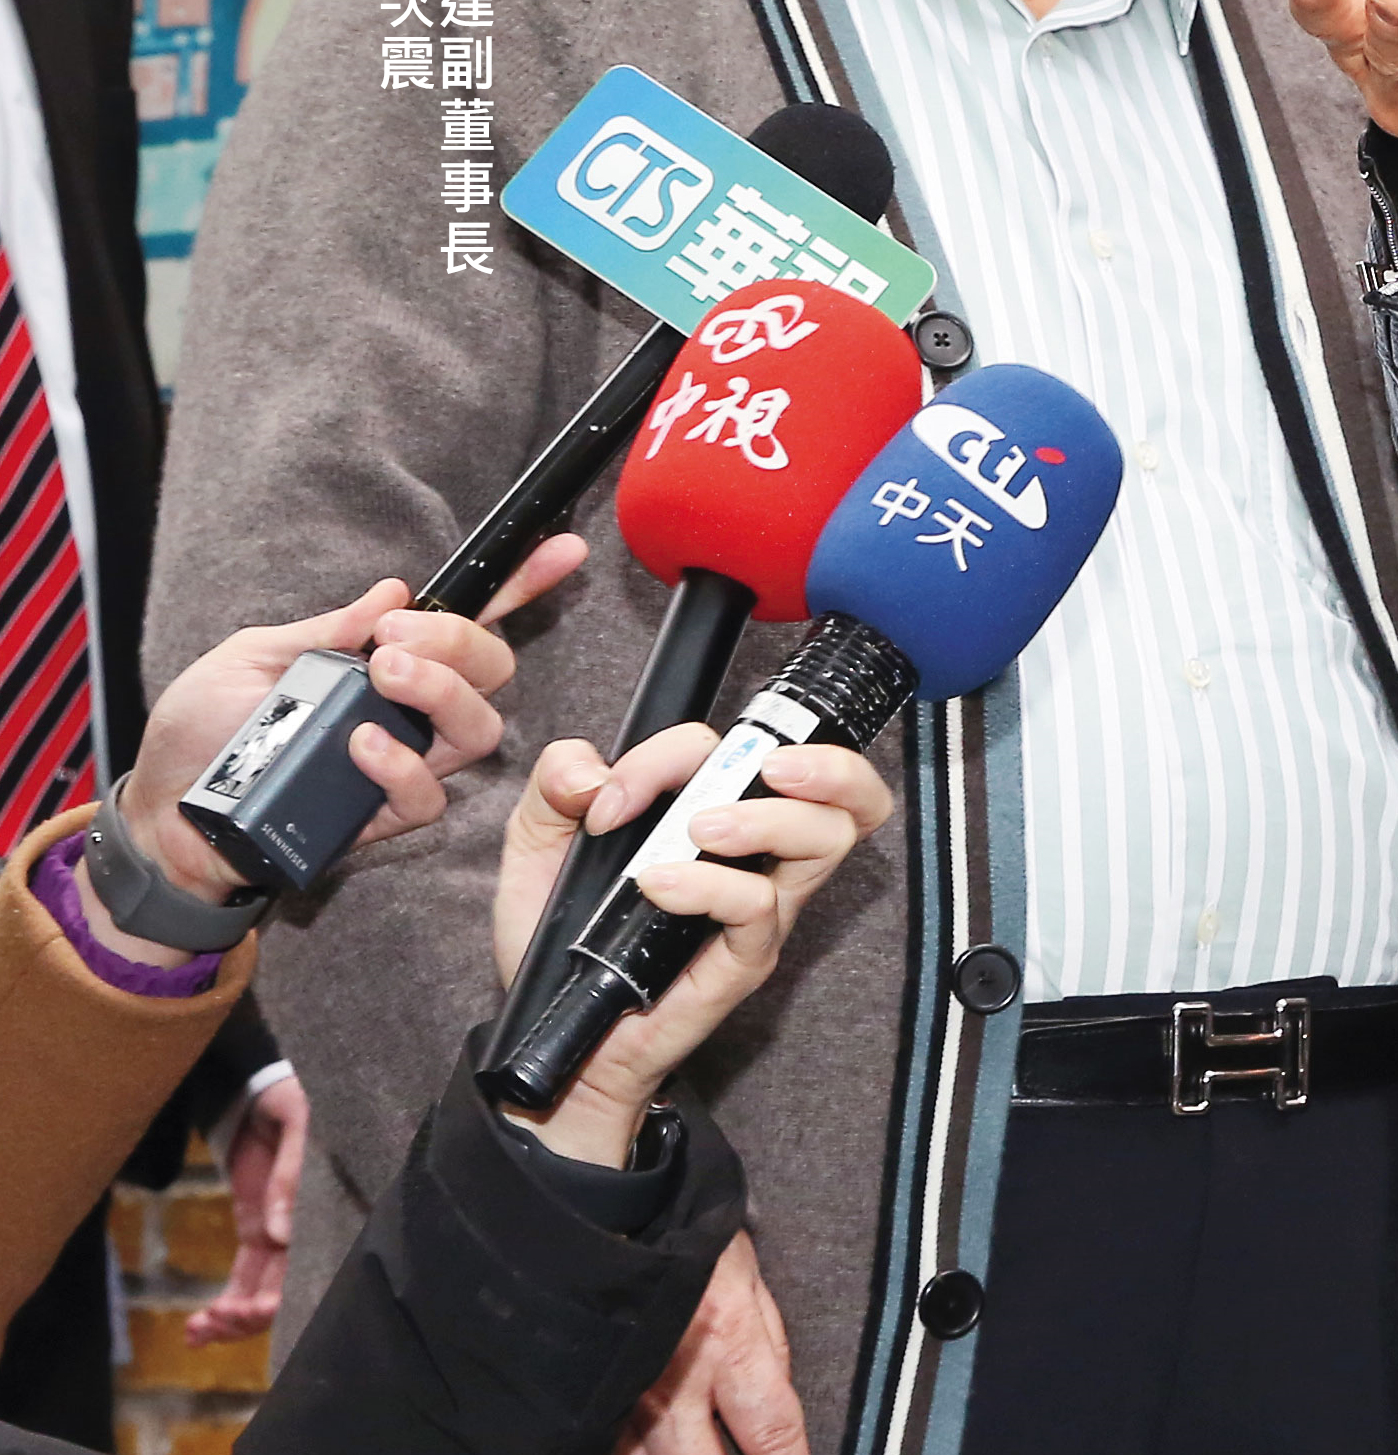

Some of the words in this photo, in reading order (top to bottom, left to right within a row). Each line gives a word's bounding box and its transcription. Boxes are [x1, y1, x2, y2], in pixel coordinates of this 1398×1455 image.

[573, 130, 704, 239] CTS
[643, 370, 793, 471] 中視
[869, 477, 995, 573] 中天
[260, 822, 309, 872] SENNHEISER
